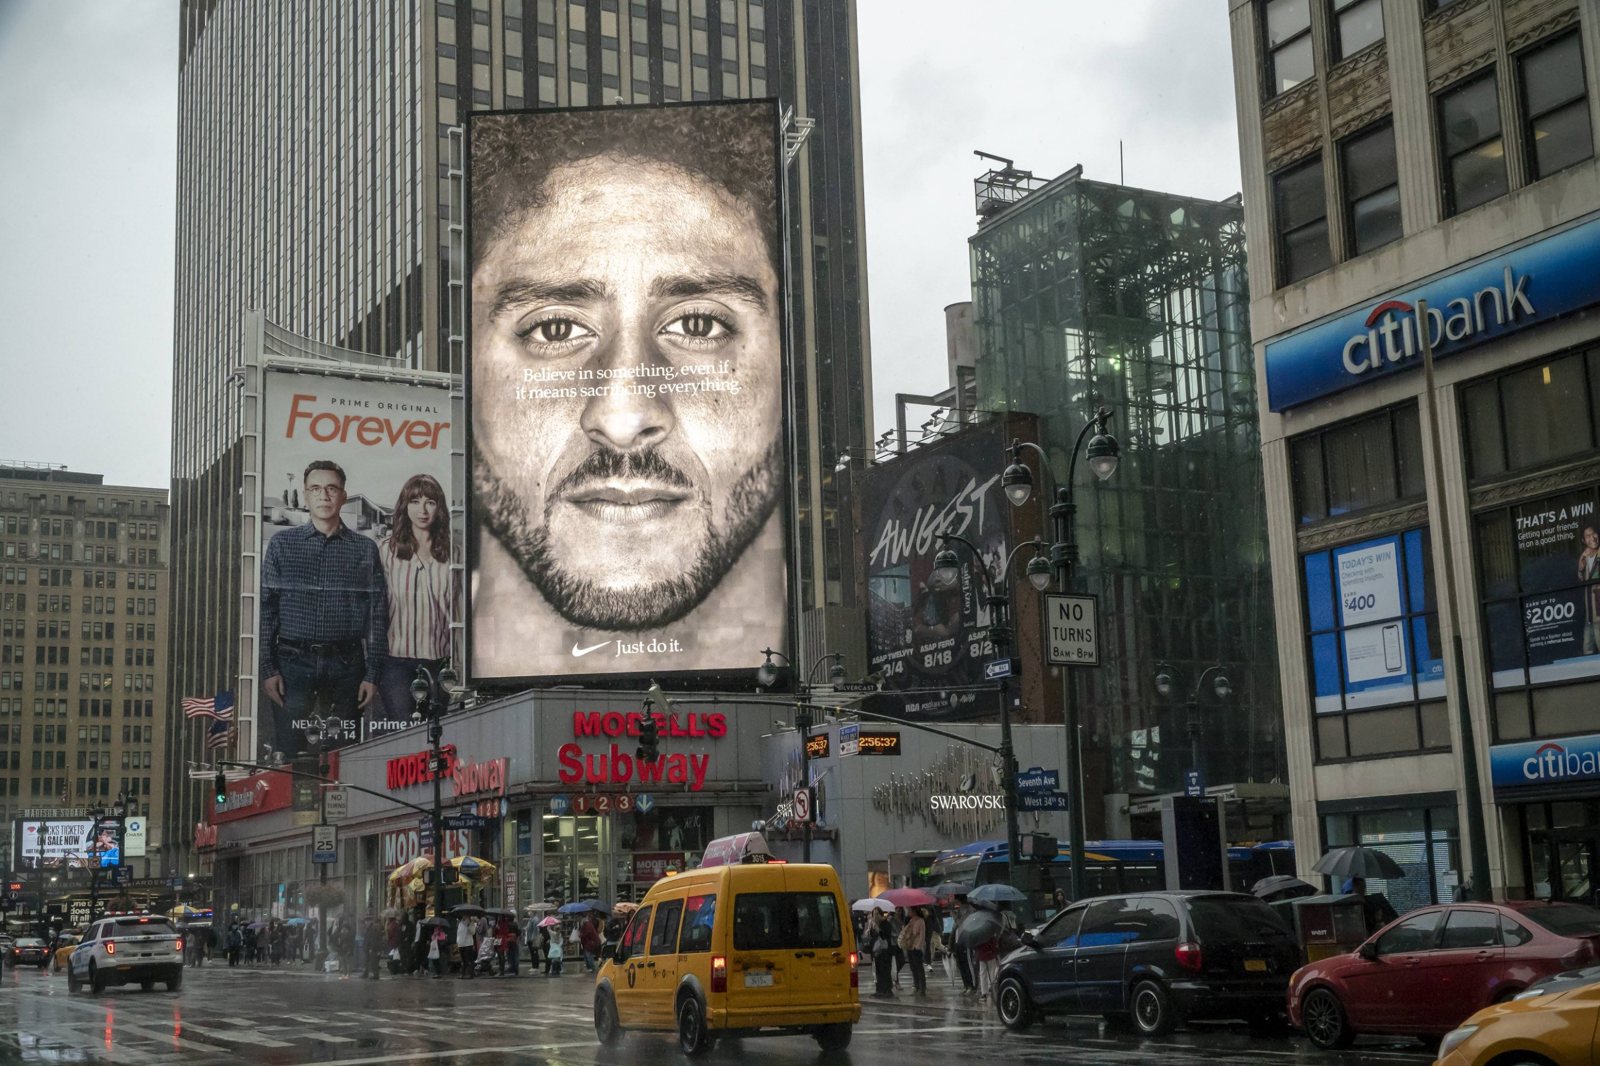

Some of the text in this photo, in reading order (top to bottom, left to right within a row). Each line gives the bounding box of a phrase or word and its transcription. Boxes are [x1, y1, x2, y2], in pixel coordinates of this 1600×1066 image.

[1342, 266, 1536, 375] citibank
[523, 360, 730, 382] Believe in something, even if
[516, 386, 527, 400] it
[529, 386, 577, 399] means
[659, 377, 743, 396] everything.
[331, 397, 439, 414] PRIME ORIGINAL
[285, 393, 451, 450] Forever
[1516, 502, 1594, 530] THAT'S A WIN
[1517, 521, 1579, 541] Getting your friends
[1540, 535, 1556, 546] good
[1342, 551, 1391, 570] TODAY'S WIN
[1344, 594, 1375, 611] $400
[1060, 603, 1083, 621] NO
[1526, 602, 1575, 624] $2,000
[1052, 626, 1092, 643] TURNS
[614, 637, 683, 657] Just do it.
[970, 640, 993, 657] 8/2
[924, 650, 952, 668] 8/18
[321, 719, 356, 729] SIES
[369, 718, 407, 732] prime
[573, 711, 728, 738] MODELL'S
[344, 731, 356, 740] 14
[859, 738, 897, 747] 2:56:37
[386, 744, 457, 790] MODEL'S
[557, 743, 711, 791] Subway
[452, 756, 505, 797] Subway
[1018, 776, 1055, 787] Seventh Ave
[577, 798, 584, 810] 1
[600, 797, 608, 809] 2
[620, 796, 629, 809] 3
[930, 795, 1006, 809] SWAROVSKI
[1024, 796, 1066, 807] West 34th St
[25, 809, 57, 818] MADISON
[61, 824, 85, 835] TICKETS
[448, 819, 464, 827] West
[478, 819, 485, 827] St
[47, 836, 63, 846] SALE
[64, 835, 80, 845] NOW
[317, 841, 333, 850] 25
[385, 829, 469, 867] MODL'S
[637, 859, 681, 868] MODELL'S
[819, 878, 829, 886] 42
